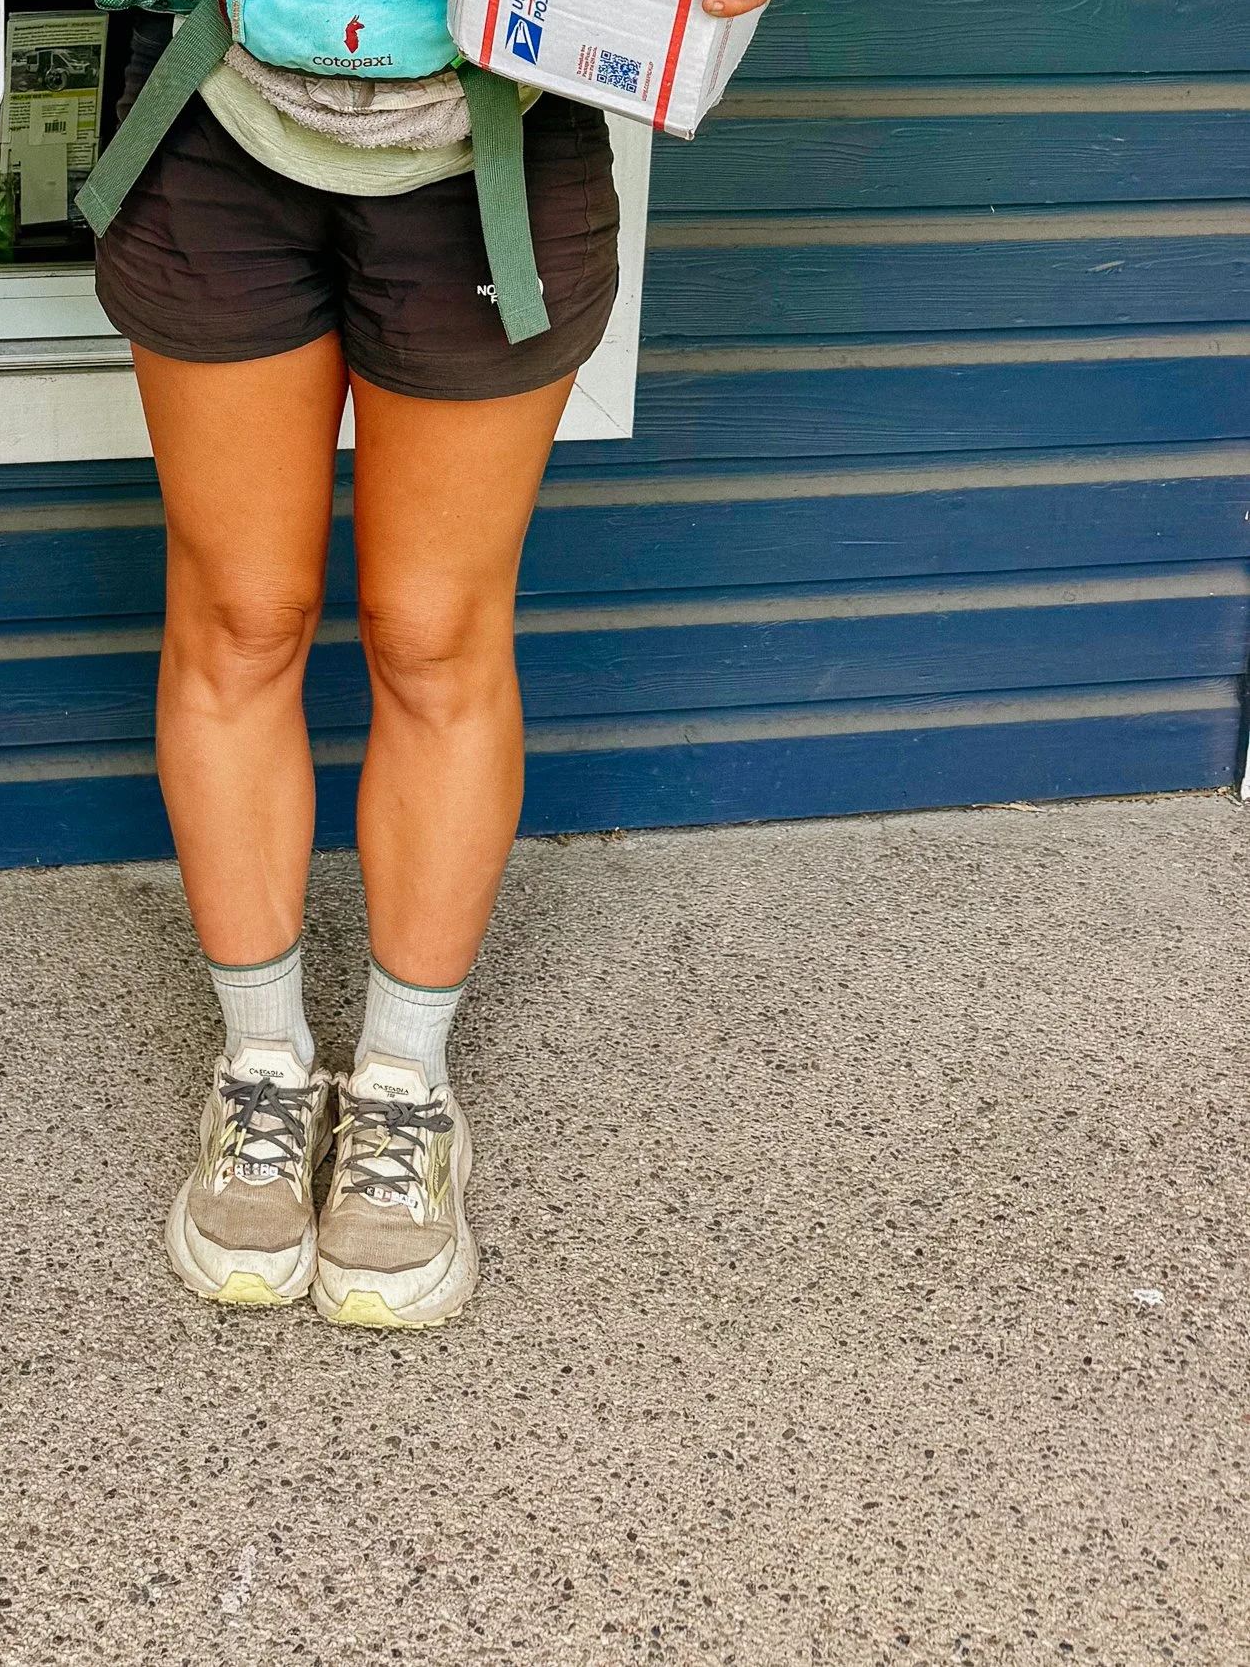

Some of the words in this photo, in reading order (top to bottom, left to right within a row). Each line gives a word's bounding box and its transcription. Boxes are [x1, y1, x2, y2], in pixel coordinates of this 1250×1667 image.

[312, 53, 394, 71] cotopaxi
[476, 284, 498, 297] NO
[372, 1082, 409, 1095] CASCADIA
